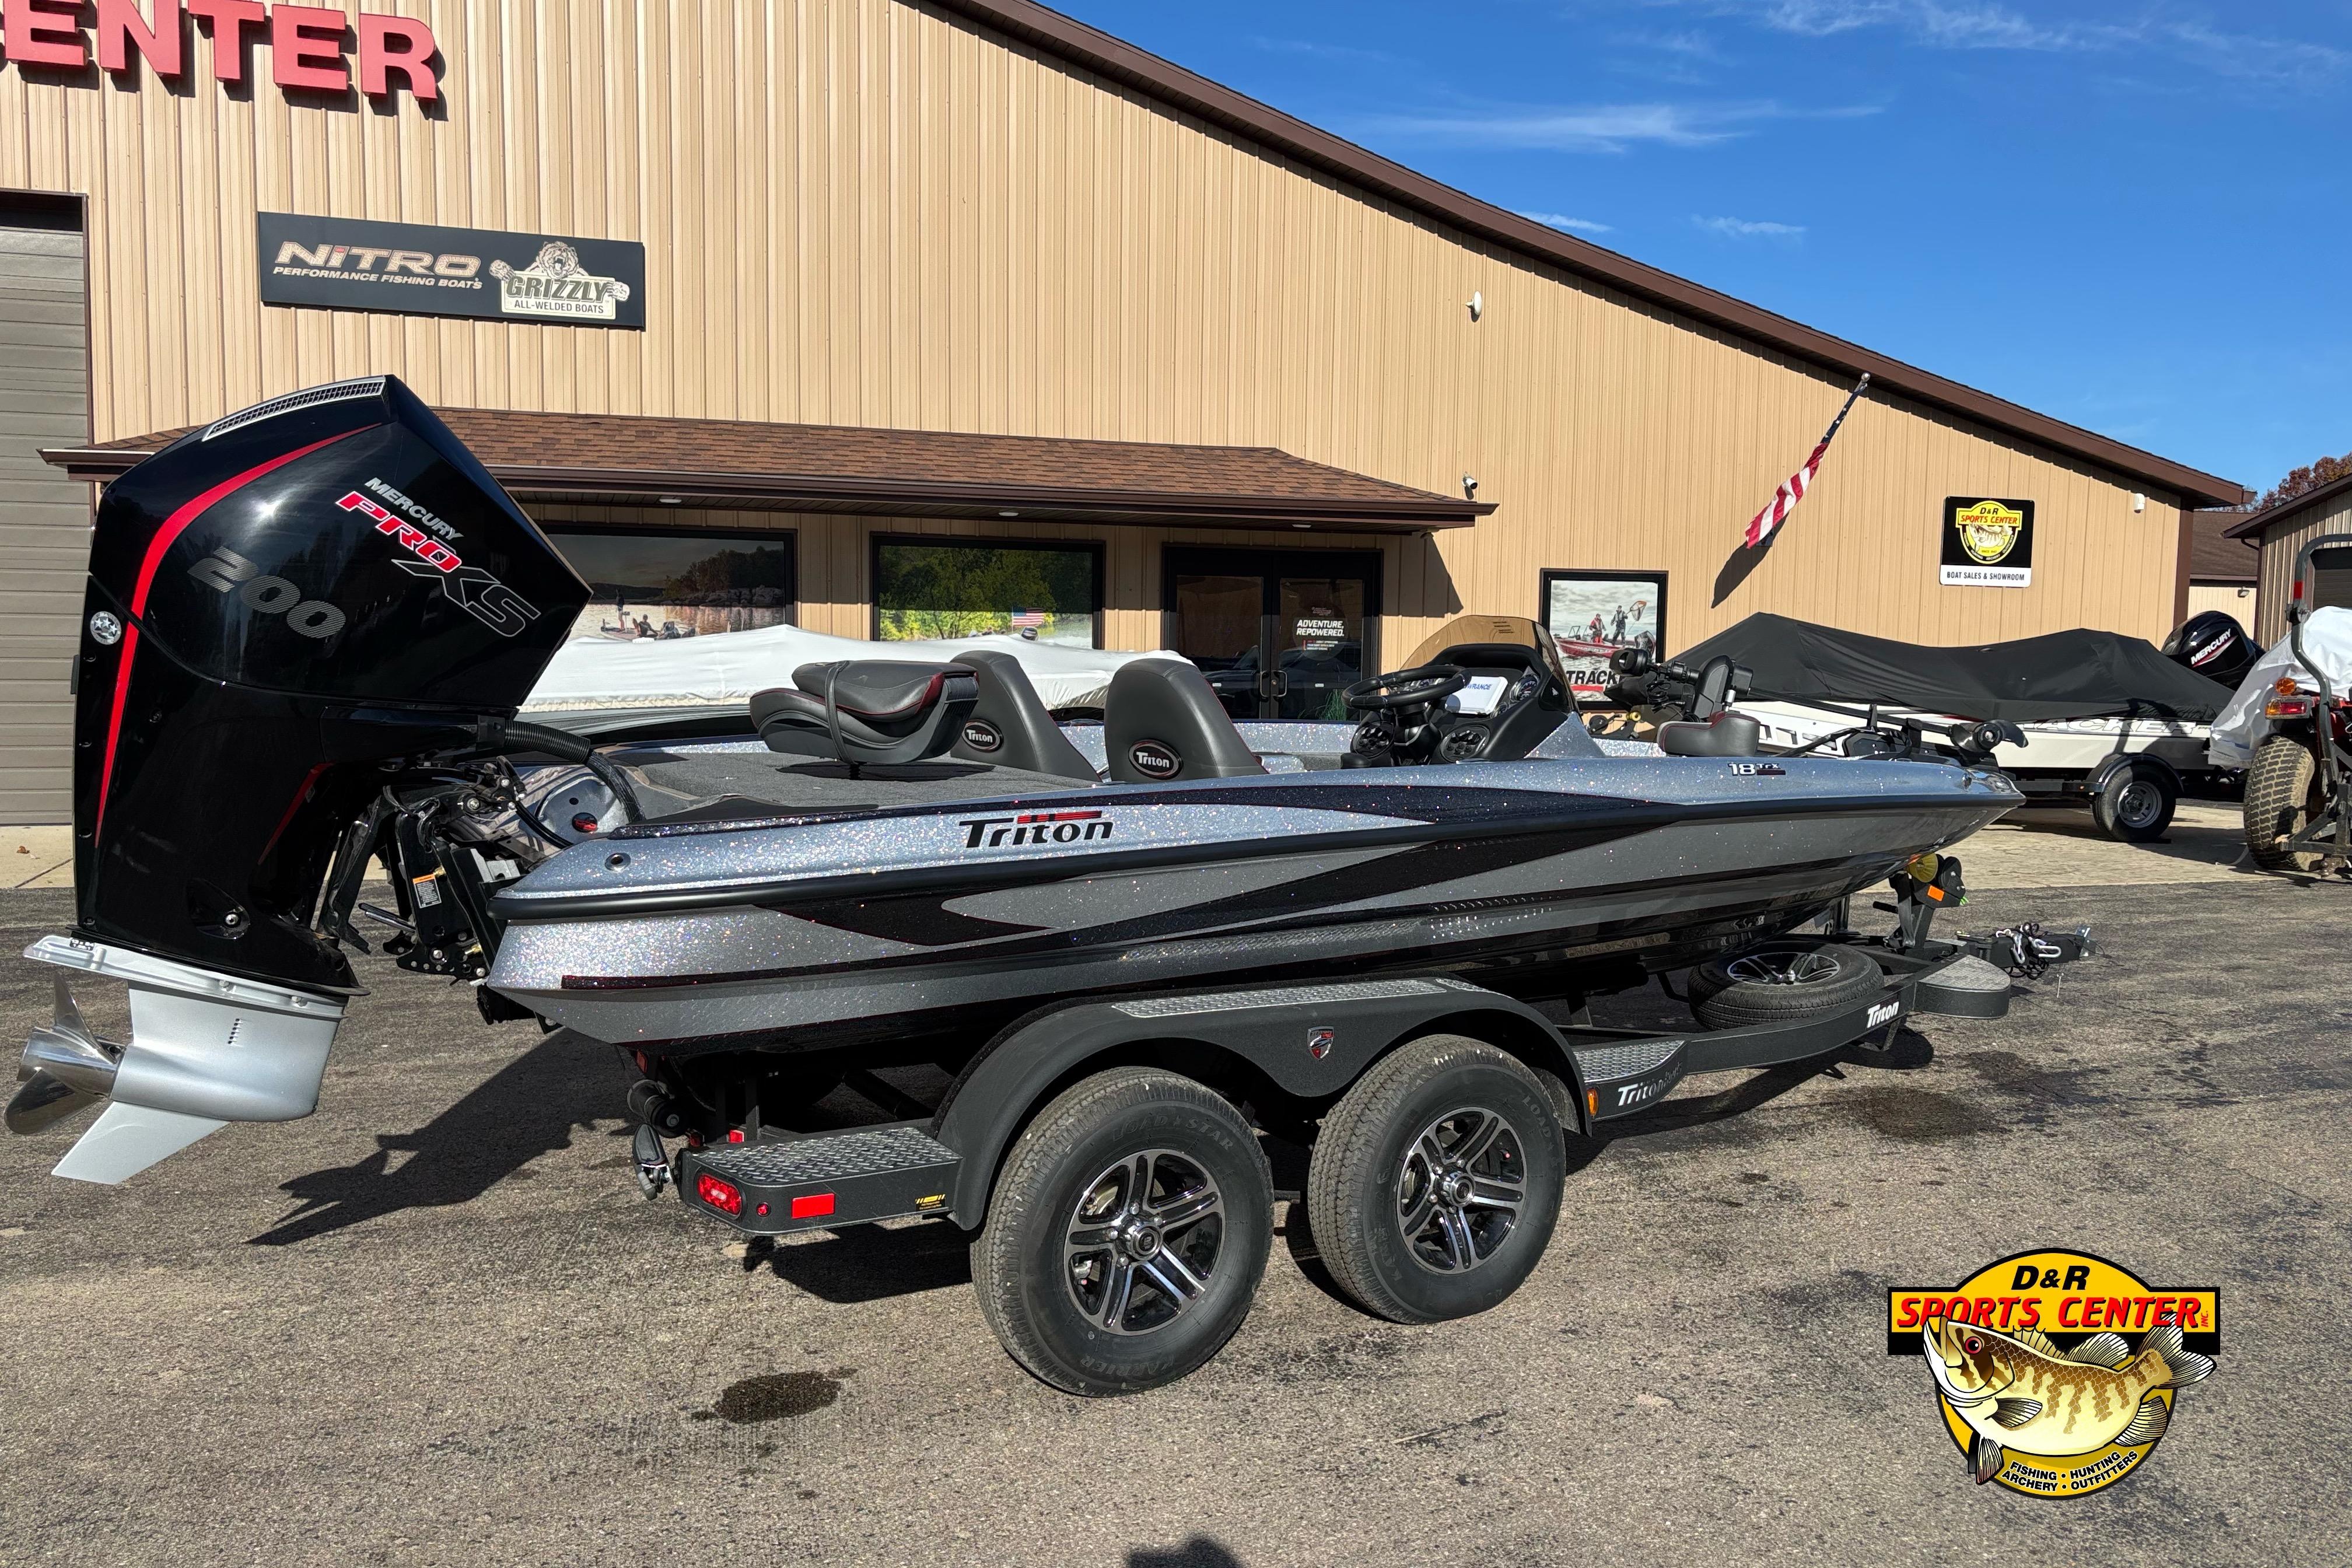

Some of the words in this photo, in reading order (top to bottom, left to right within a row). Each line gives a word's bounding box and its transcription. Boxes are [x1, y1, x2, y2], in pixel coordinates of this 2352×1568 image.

[273, 267, 378, 282] PERFORMANCE
[380, 275, 435, 286] FISHING
[438, 278, 483, 290] BOATS
[505, 275, 609, 303] GRIZZLY
[514, 299, 572, 312] ALL-WELDED
[575, 303, 604, 314] BOATS
[364, 477, 465, 541] MERCURY
[1961, 514, 1988, 523] SPORTS
[1990, 516, 2018, 524] CENTER
[335, 490, 463, 573] PRO
[1947, 571, 1962, 579] BOAT
[1989, 572, 2025, 581] SHOWROOM
[186, 545, 347, 639] 200
[390, 558, 542, 638] XS
[1296, 628, 1344, 637] REPOWERED.
[1297, 619, 1344, 629] ADVENTURE,
[2190, 628, 2231, 665] MERCURY
[1565, 670, 1624, 685] TRACK
[966, 729, 993, 743] Triton
[2017, 718, 2197, 734] ACKER
[1136, 751, 1170, 768] Triton
[1727, 762, 1755, 776] 18
[958, 817, 1114, 848] Triton
[1867, 1001, 1899, 1028] Triton
[1618, 1078, 1664, 1107] Triton
